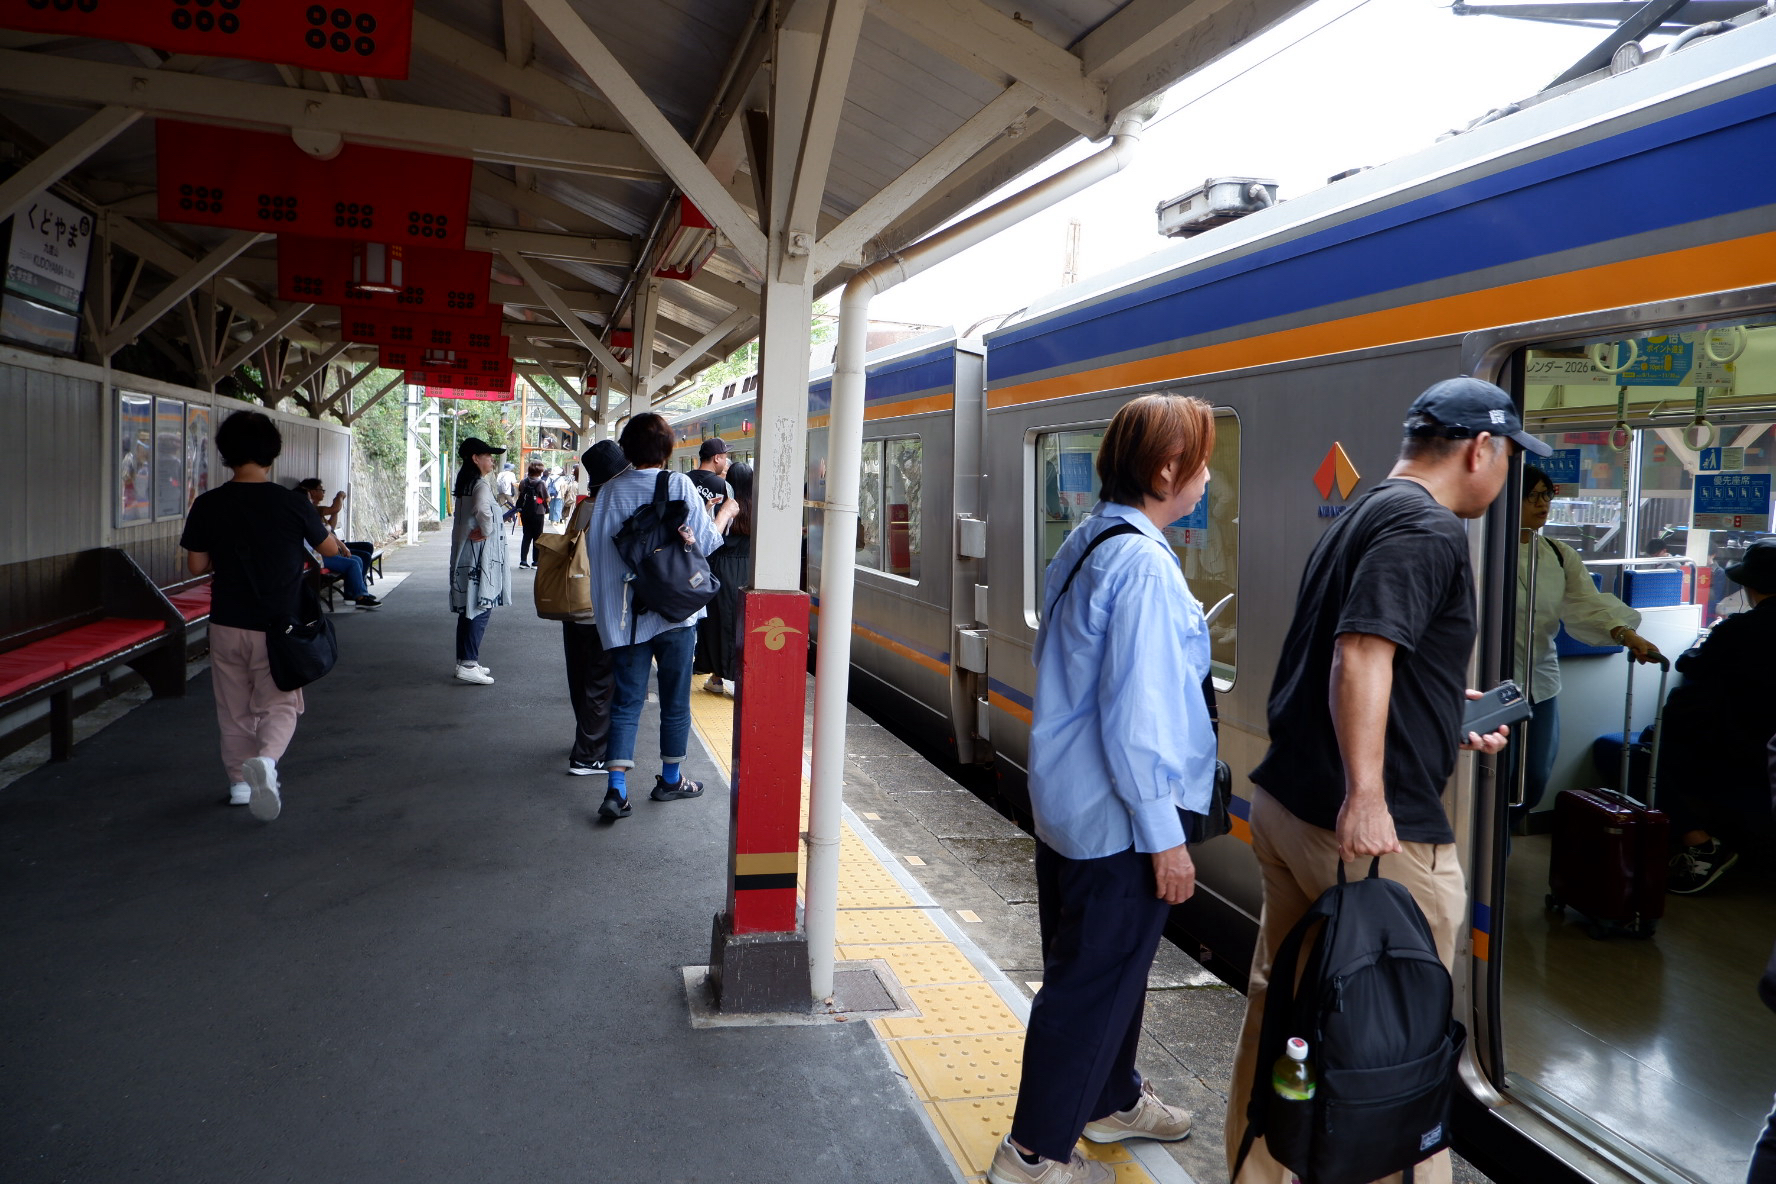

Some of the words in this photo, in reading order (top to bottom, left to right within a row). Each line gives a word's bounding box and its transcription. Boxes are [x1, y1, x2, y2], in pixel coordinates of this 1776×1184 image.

[28, 203, 78, 248] くどやま
[33, 255, 64, 276] KUDOYAMA
[1565, 361, 1589, 373] 2026
[1713, 475, 1750, 486] 優先座席
